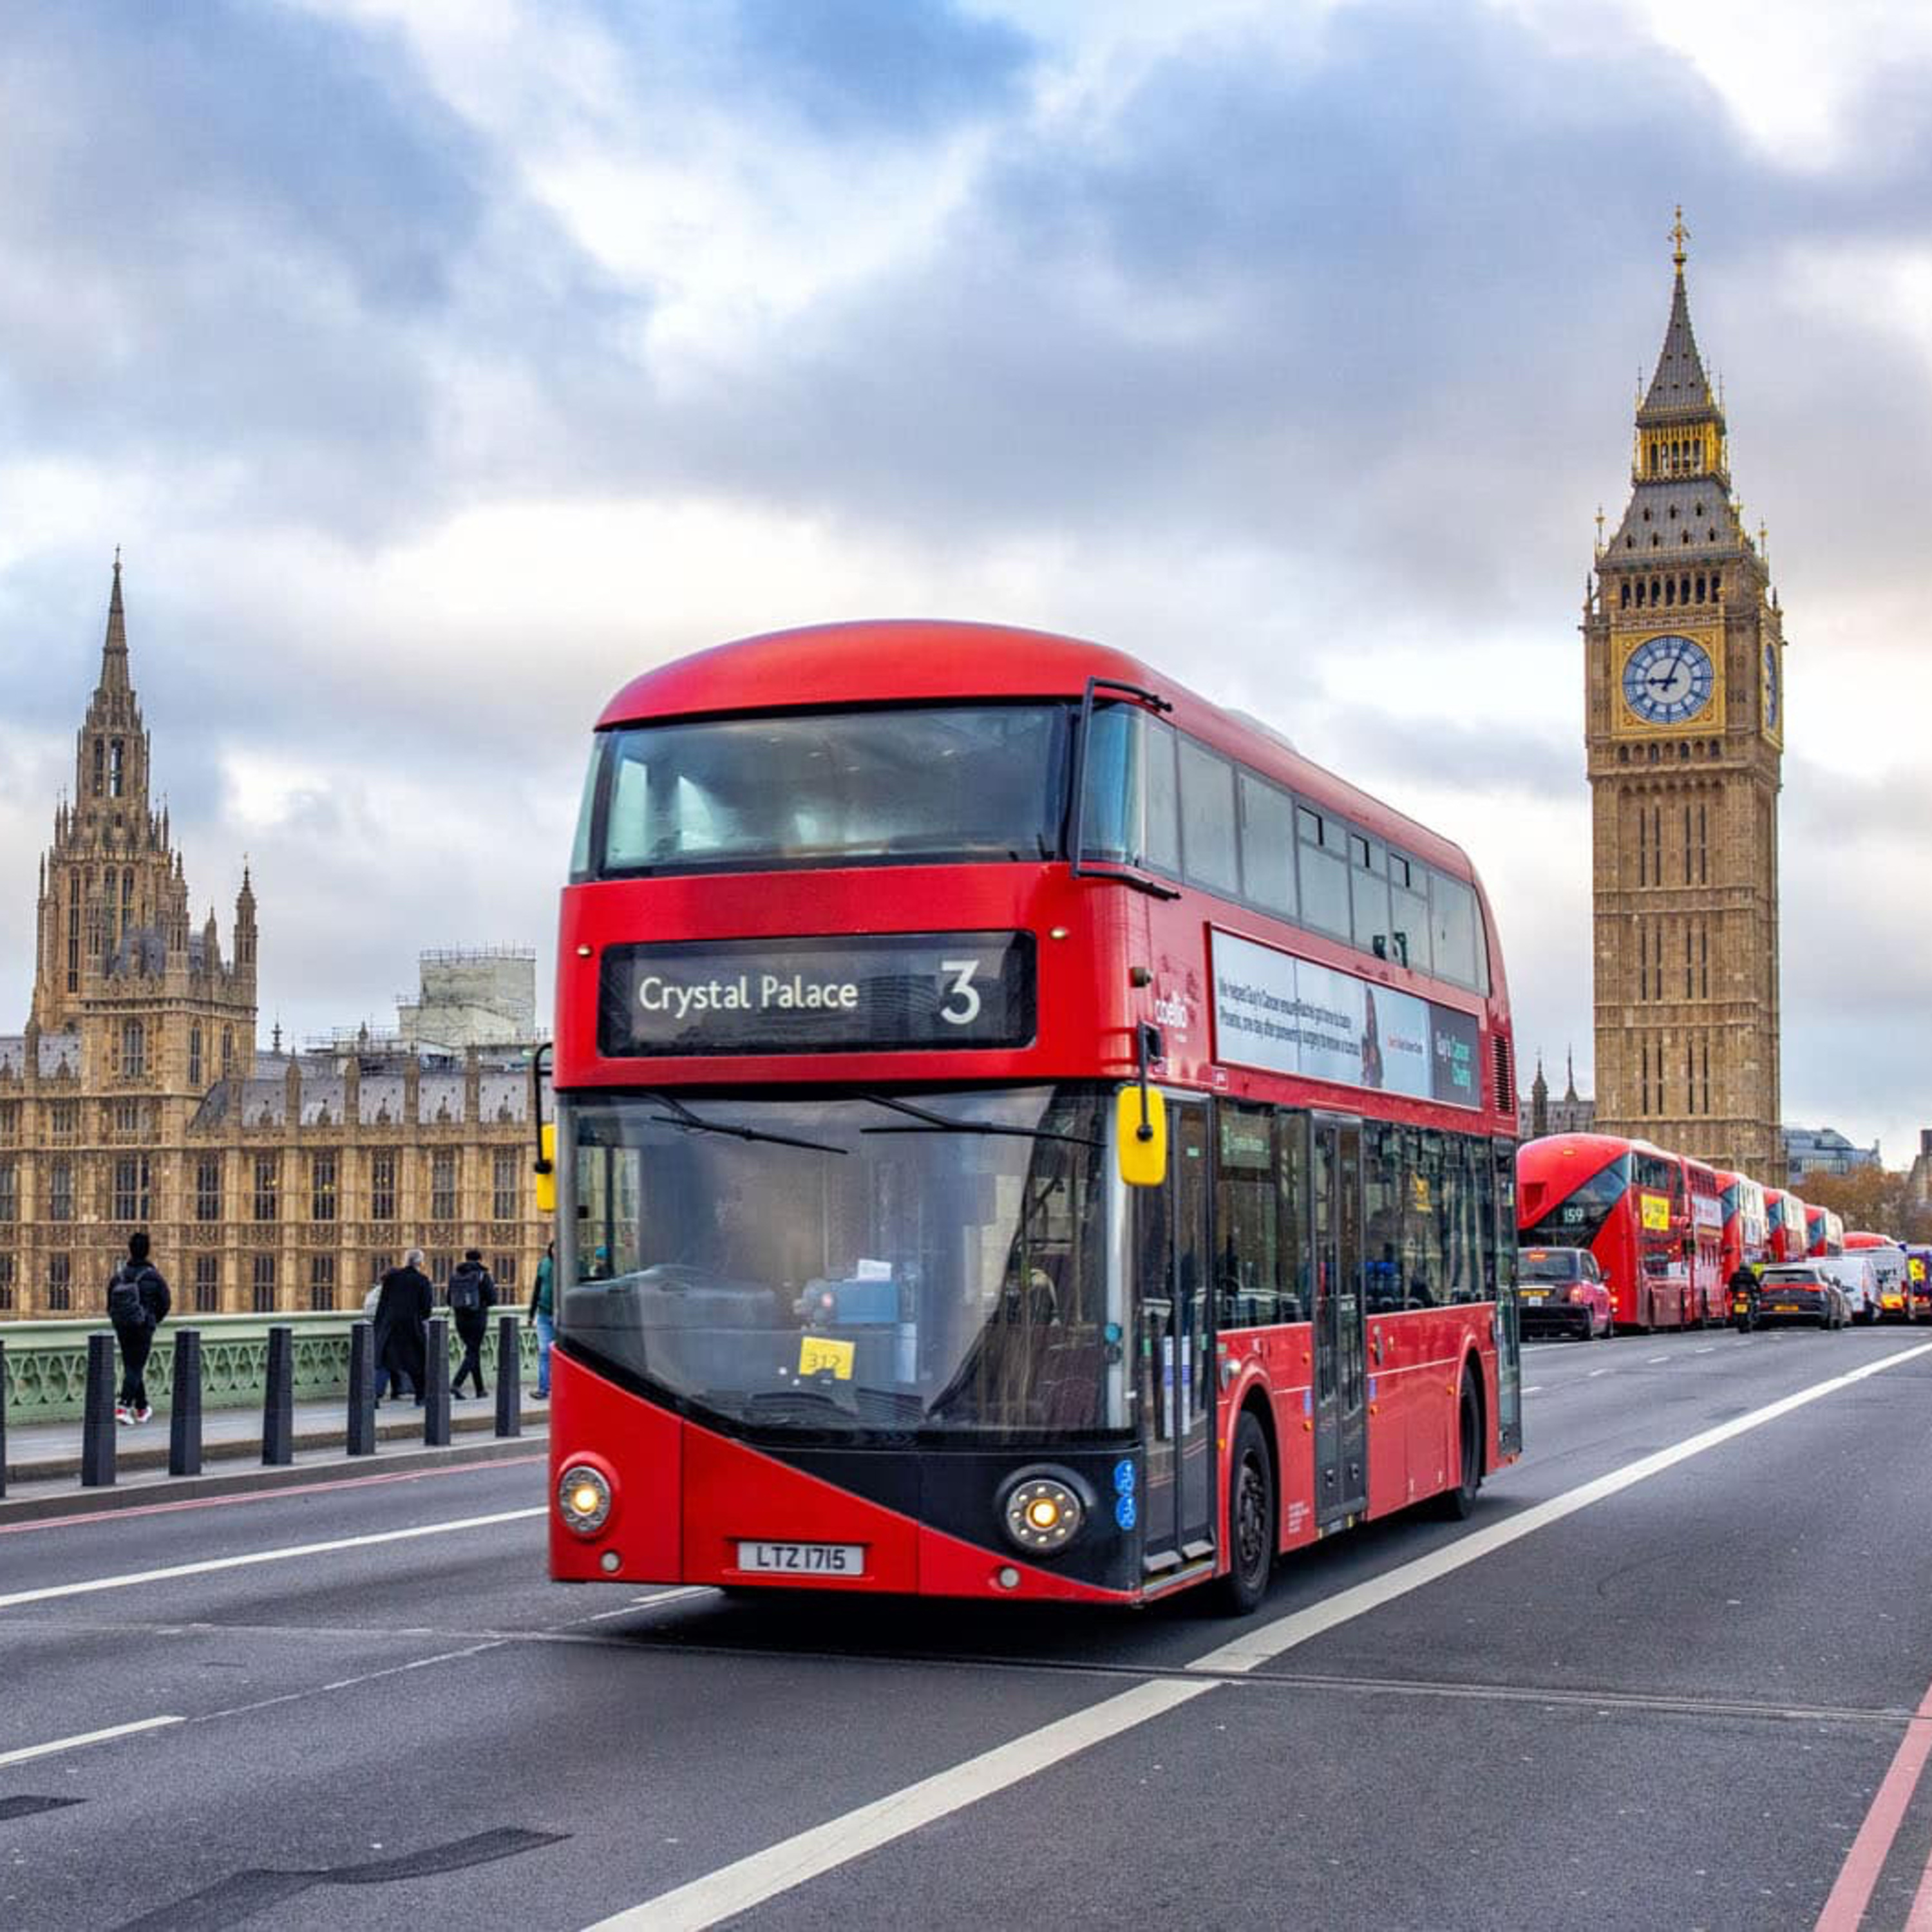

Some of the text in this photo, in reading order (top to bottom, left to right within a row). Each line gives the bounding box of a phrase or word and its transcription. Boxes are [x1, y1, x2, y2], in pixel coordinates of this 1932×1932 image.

[639, 975, 858, 1018] Crystal Palace
[941, 961, 981, 1025] 3
[1564, 1208, 1584, 1223] 159
[757, 1546, 846, 1570] LTZ 1715
